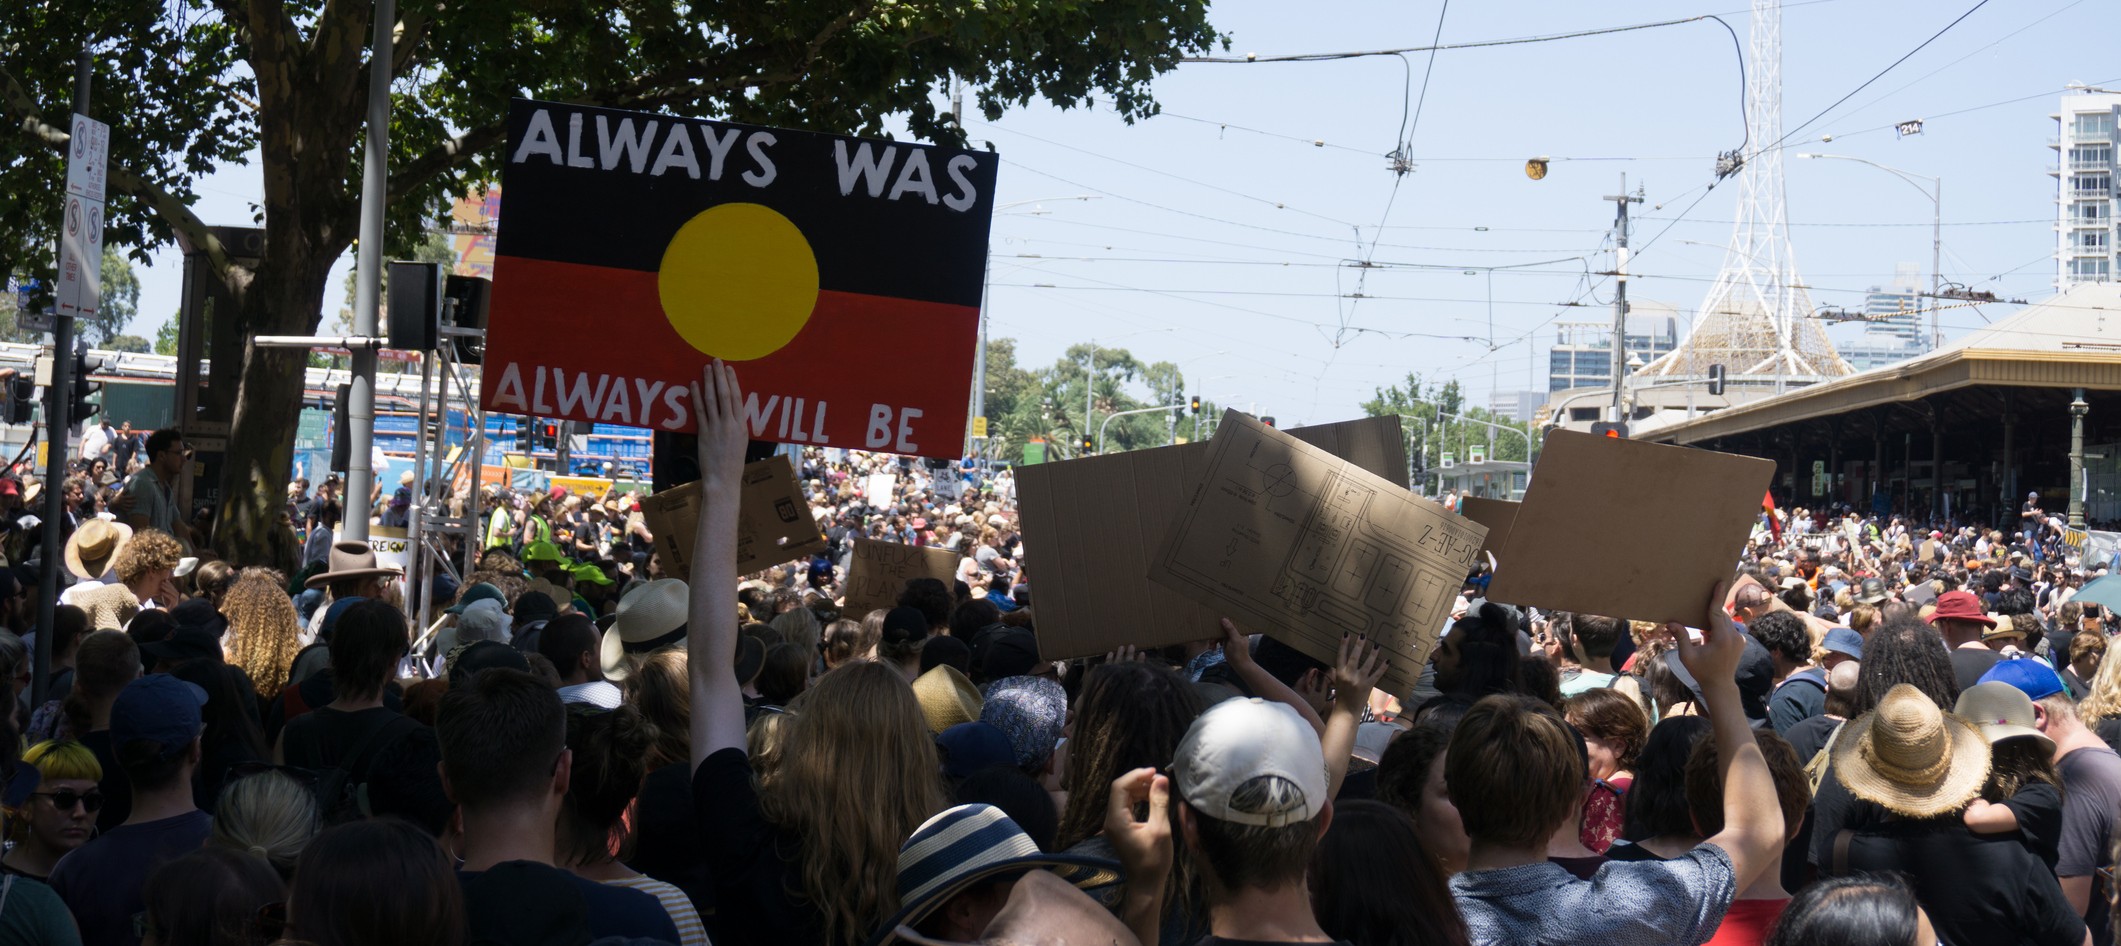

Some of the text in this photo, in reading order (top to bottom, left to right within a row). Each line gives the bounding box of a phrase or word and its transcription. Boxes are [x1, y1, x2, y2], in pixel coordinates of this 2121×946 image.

[1901, 122, 1919, 135] 214
[513, 109, 978, 213] ALWAYS WAS
[491, 362, 923, 452] ALWAYS WILL BE
[855, 543, 930, 570] UNFUCK
[879, 562, 906, 579] THE
[854, 575, 897, 601] PLAN
